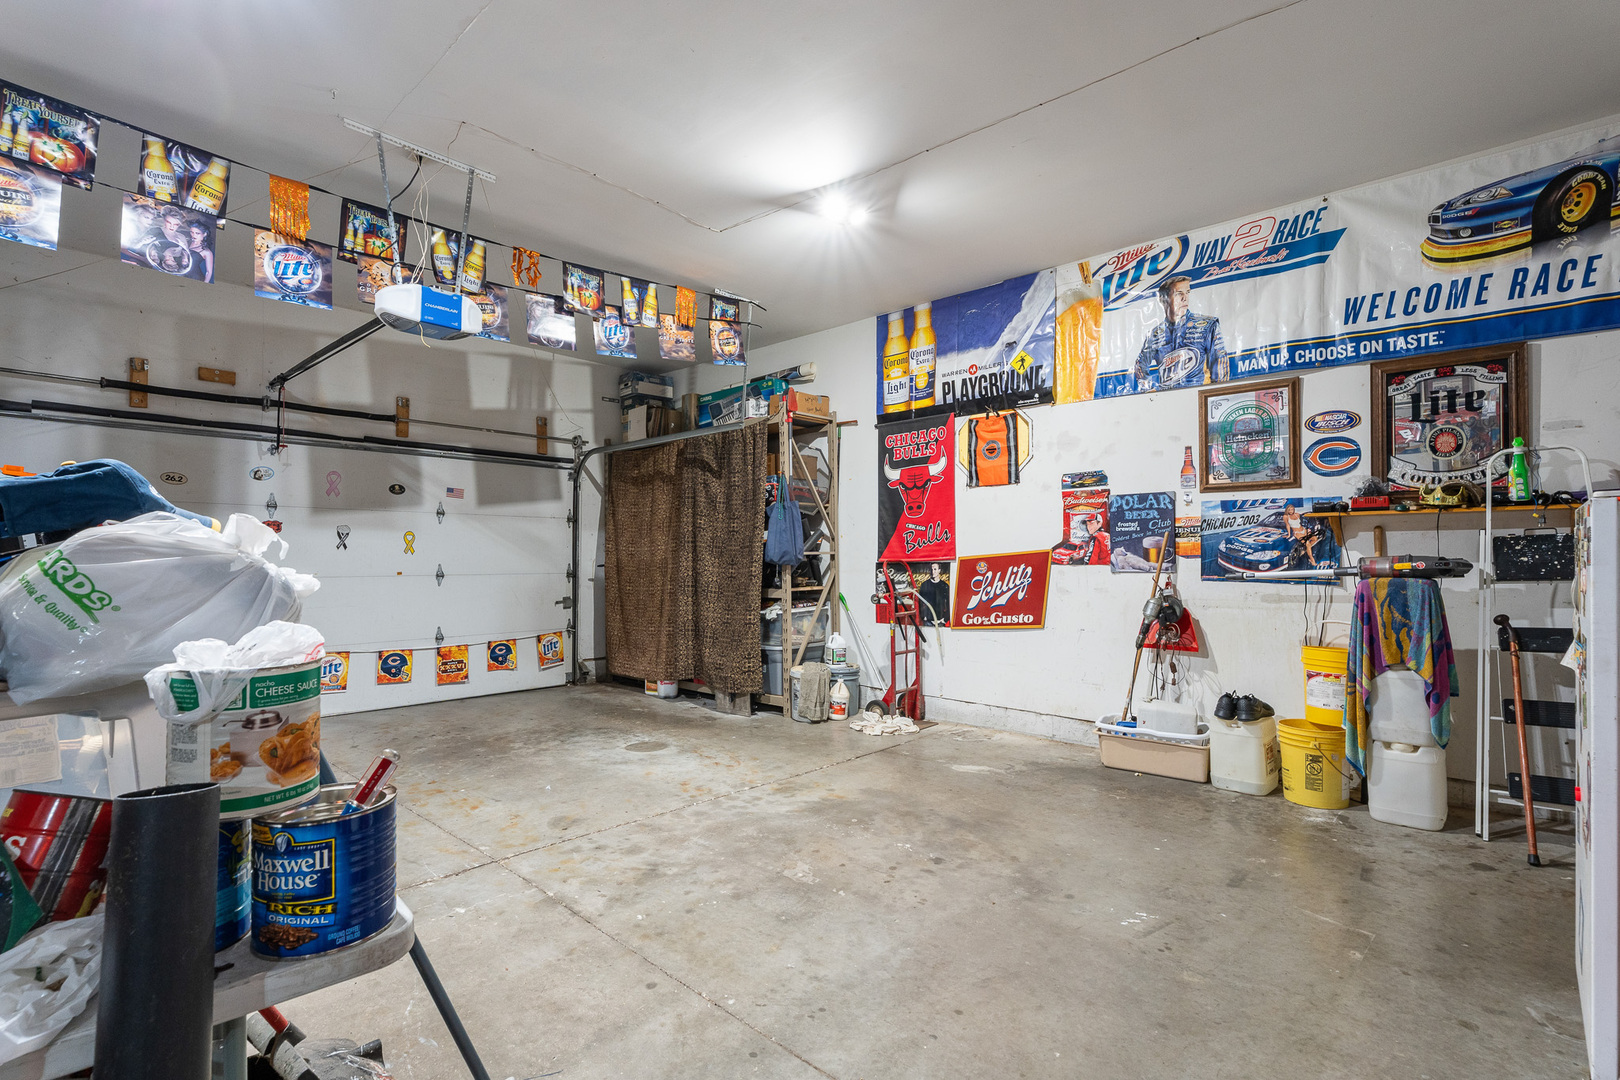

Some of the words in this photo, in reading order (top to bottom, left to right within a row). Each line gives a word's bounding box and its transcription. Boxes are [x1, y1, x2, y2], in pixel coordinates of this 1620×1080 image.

[3, 88, 41, 110] TREAT
[146, 170, 174, 181] Corona
[1571, 171, 1607, 190] GOODYEAR
[0, 189, 32, 201] UINE
[194, 183, 223, 201] Corona
[1442, 210, 1473, 219] DODGE
[1191, 235, 1232, 269] WAY
[1225, 216, 1277, 262] 2
[1272, 206, 1328, 245] RACE
[280, 253, 307, 262] Miller
[1107, 244, 1156, 272] Miller
[273, 260, 314, 277] Lite
[463, 275, 480, 287] Light
[1103, 246, 1174, 307] Lite
[1343, 272, 1494, 326] WELCOME
[1508, 254, 1603, 301] RACE
[424, 302, 459, 314] CHAMBERLAIN
[910, 347, 935, 361] Corona
[1237, 357, 1267, 374] MAN
[1270, 352, 1291, 368] UP.
[1294, 342, 1358, 364] CHOOSE
[1359, 338, 1383, 355] ON
[1386, 332, 1445, 352] TASTE.
[883, 354, 908, 370] Corona
[915, 357, 931, 366] Extra
[941, 369, 968, 379] WARREN
[978, 360, 1009, 372] MILLER'S
[886, 381, 907, 395] Light
[941, 364, 1046, 405] PLAYGROUND
[1391, 383, 1412, 393] GREAT
[1412, 371, 1432, 381] TASTE
[1480, 373, 1505, 381] FILLING
[1408, 389, 1487, 424] Lite
[1314, 419, 1351, 428] BUSCH
[1325, 413, 1348, 421] NASCAR
[885, 426, 947, 448] CHICAGO
[1226, 433, 1271, 442] Heineken
[894, 442, 937, 461] BULLS
[164, 474, 184, 483] 26.2
[1063, 496, 1110, 506] Budweiser
[1110, 493, 1173, 513] POLAR
[1123, 509, 1161, 520] BEER
[1237, 514, 1261, 527] 2003
[905, 523, 927, 531] CHICAGO
[1148, 518, 1172, 530] Club
[903, 520, 951, 554] Bulls
[1111, 535, 1130, 543] Coldest
[1131, 531, 1145, 539] Beer
[1226, 543, 1254, 553] DODGE
[38, 549, 112, 611] ARDS
[966, 563, 1033, 611] Schlitz
[34, 594, 48, 604] &
[44, 602, 81, 631] Quality
[961, 613, 982, 625] Go
[989, 611, 1034, 625] Gusto
[542, 640, 559, 656] Lite
[255, 680, 275, 688] nacho
[255, 683, 294, 698] CHEESE
[297, 678, 318, 692] SAUCE
[264, 795, 275, 803] NET
[254, 848, 330, 873] Maxwell
[258, 871, 318, 892] House
[269, 902, 334, 916] RICH
[268, 914, 329, 926] ORIGINAL
